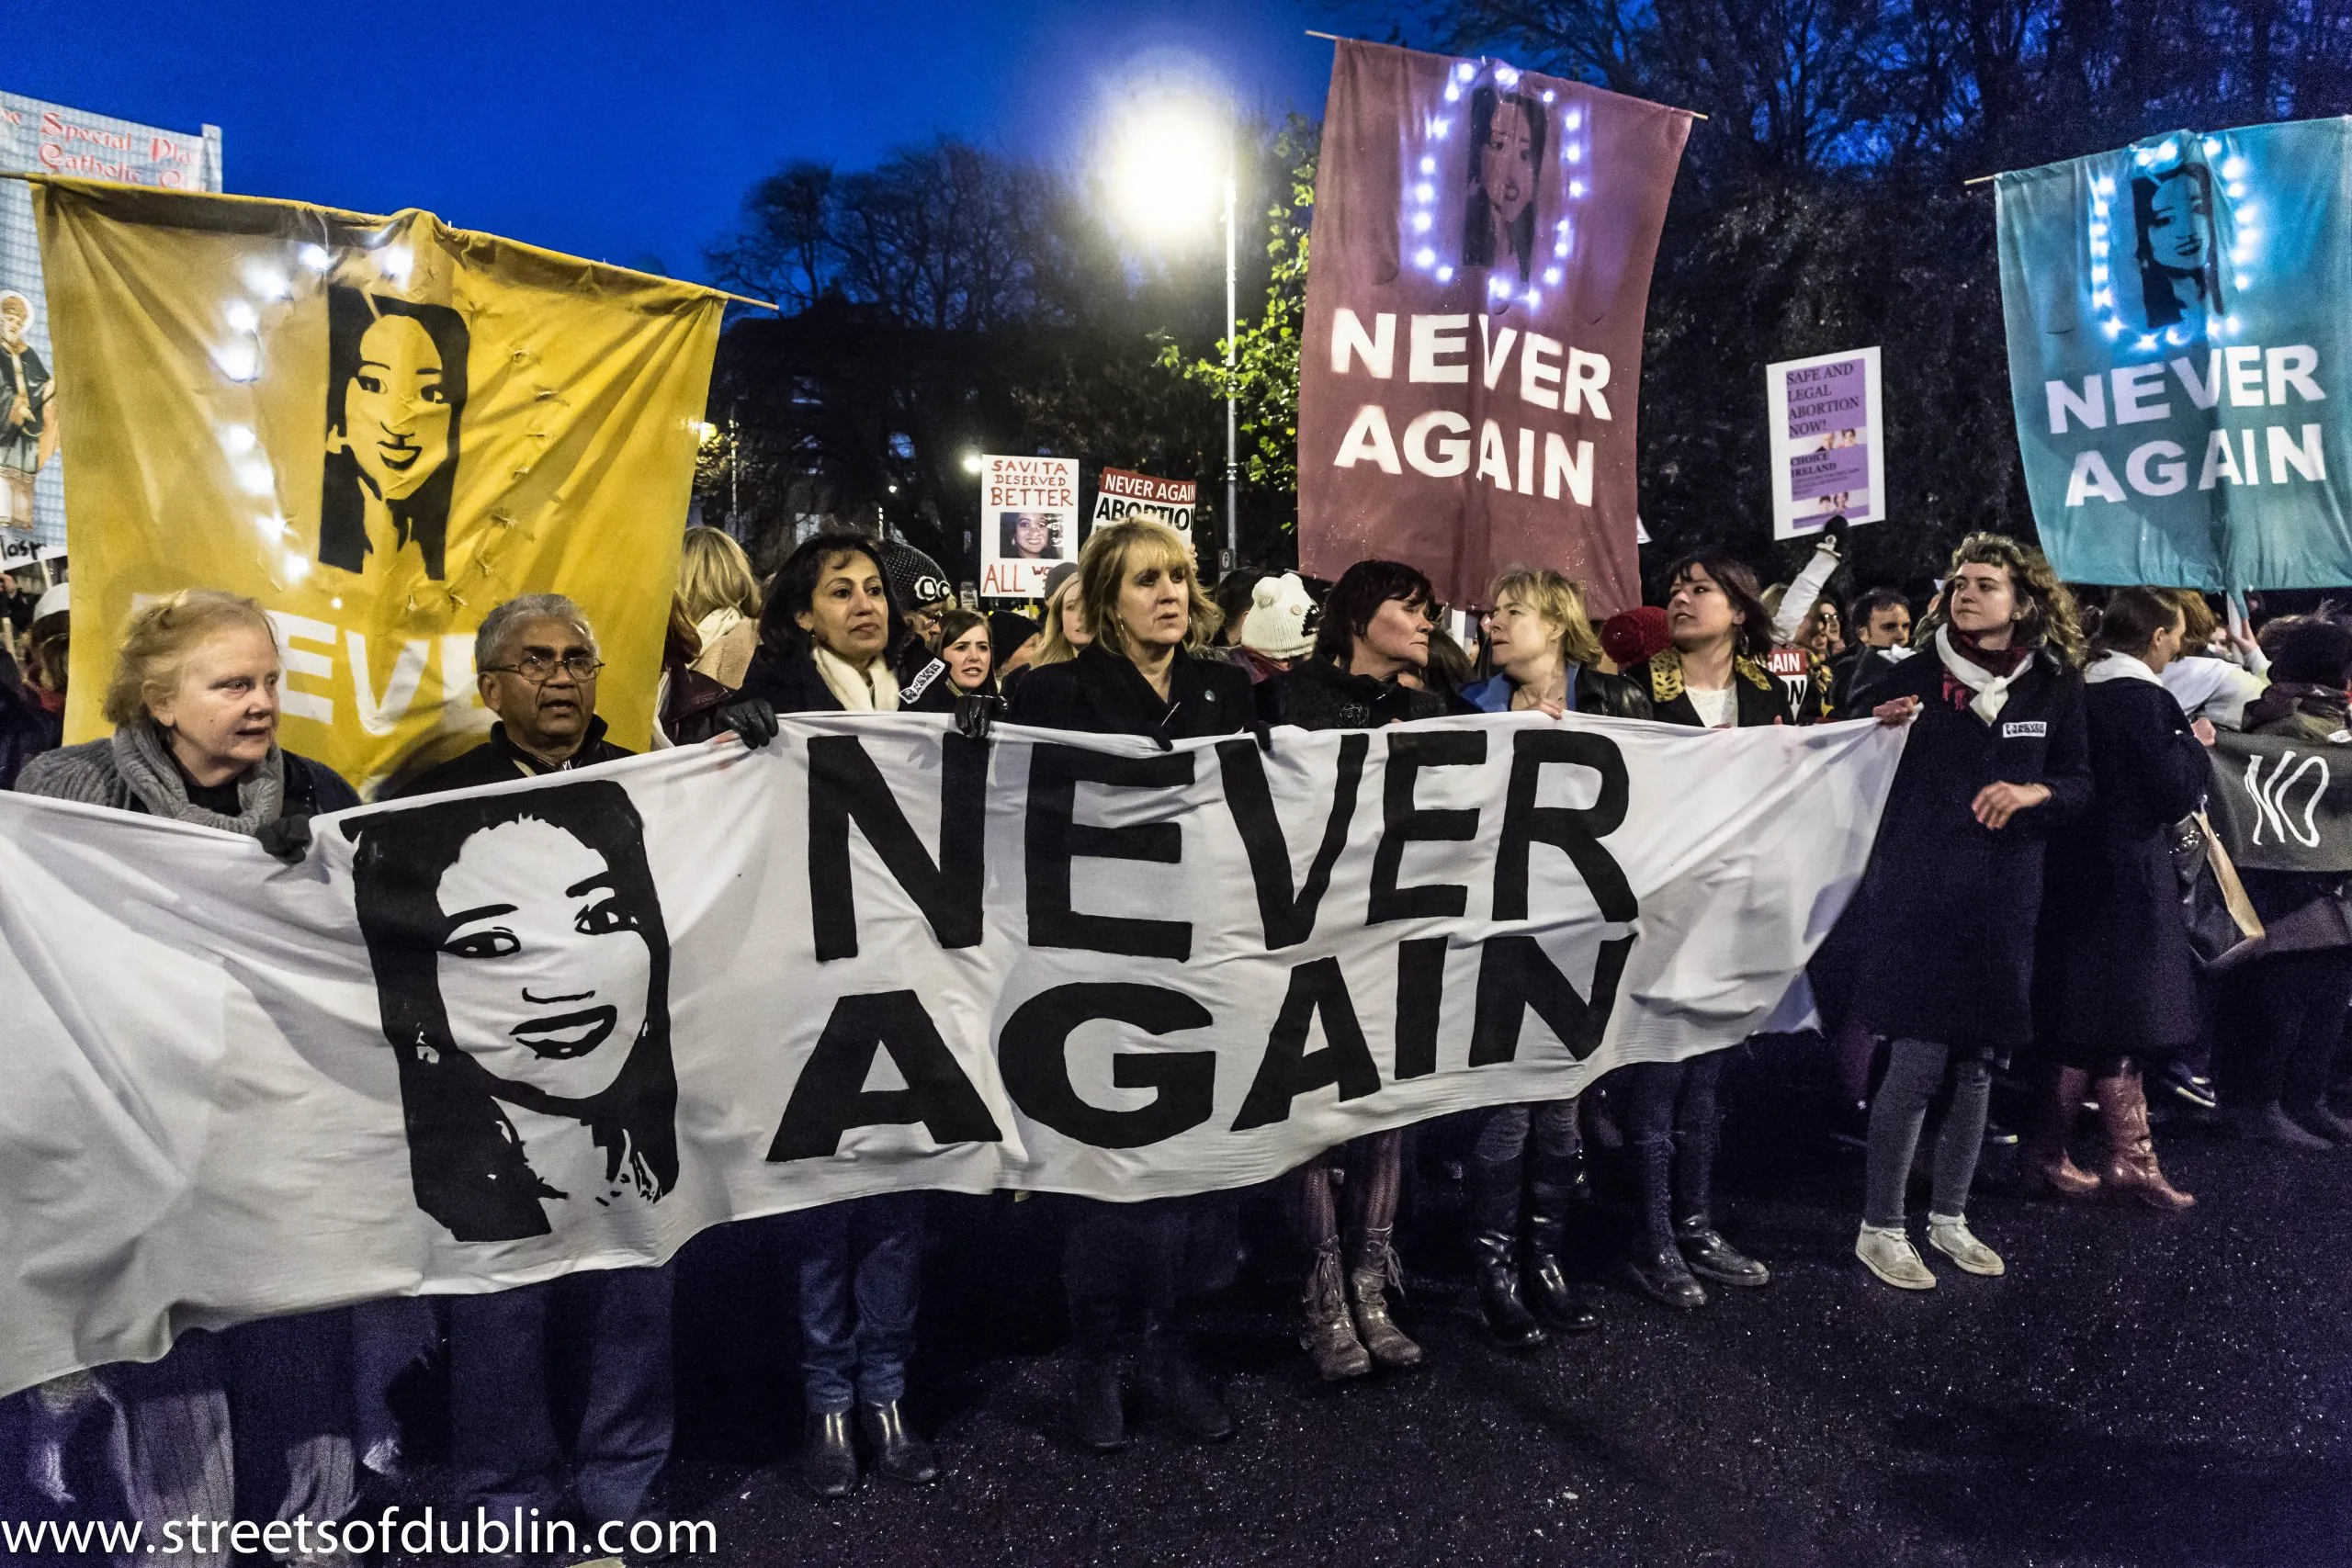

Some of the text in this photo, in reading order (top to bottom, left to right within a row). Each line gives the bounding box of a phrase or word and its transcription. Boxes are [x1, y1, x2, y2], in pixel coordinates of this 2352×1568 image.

[40, 112, 132, 152] Special
[150, 137, 191, 164] Pla
[39, 142, 143, 184] Catholic
[1330, 308, 1612, 421] NEVER
[1786, 363, 1854, 385] SAFE AND
[1787, 384, 1832, 402] LEGAL
[2044, 344, 2326, 434] NEVER
[1788, 396, 1860, 420] ABORTION
[1789, 419, 1826, 438] NOW!
[991, 460, 1069, 475] SAVITA
[1333, 404, 1595, 507] AGAIN
[1791, 462, 1837, 478] IRELAND
[2064, 423, 2327, 507] AGAIN
[995, 474, 1067, 487] DESERVED
[1104, 473, 1154, 498] NEVER
[990, 487, 1074, 506] BETTER
[982, 564, 1025, 594] ALL
[2244, 750, 2330, 847] NO
[807, 729, 1639, 963] NEVER
[765, 932, 1638, 1162] AGAIN
